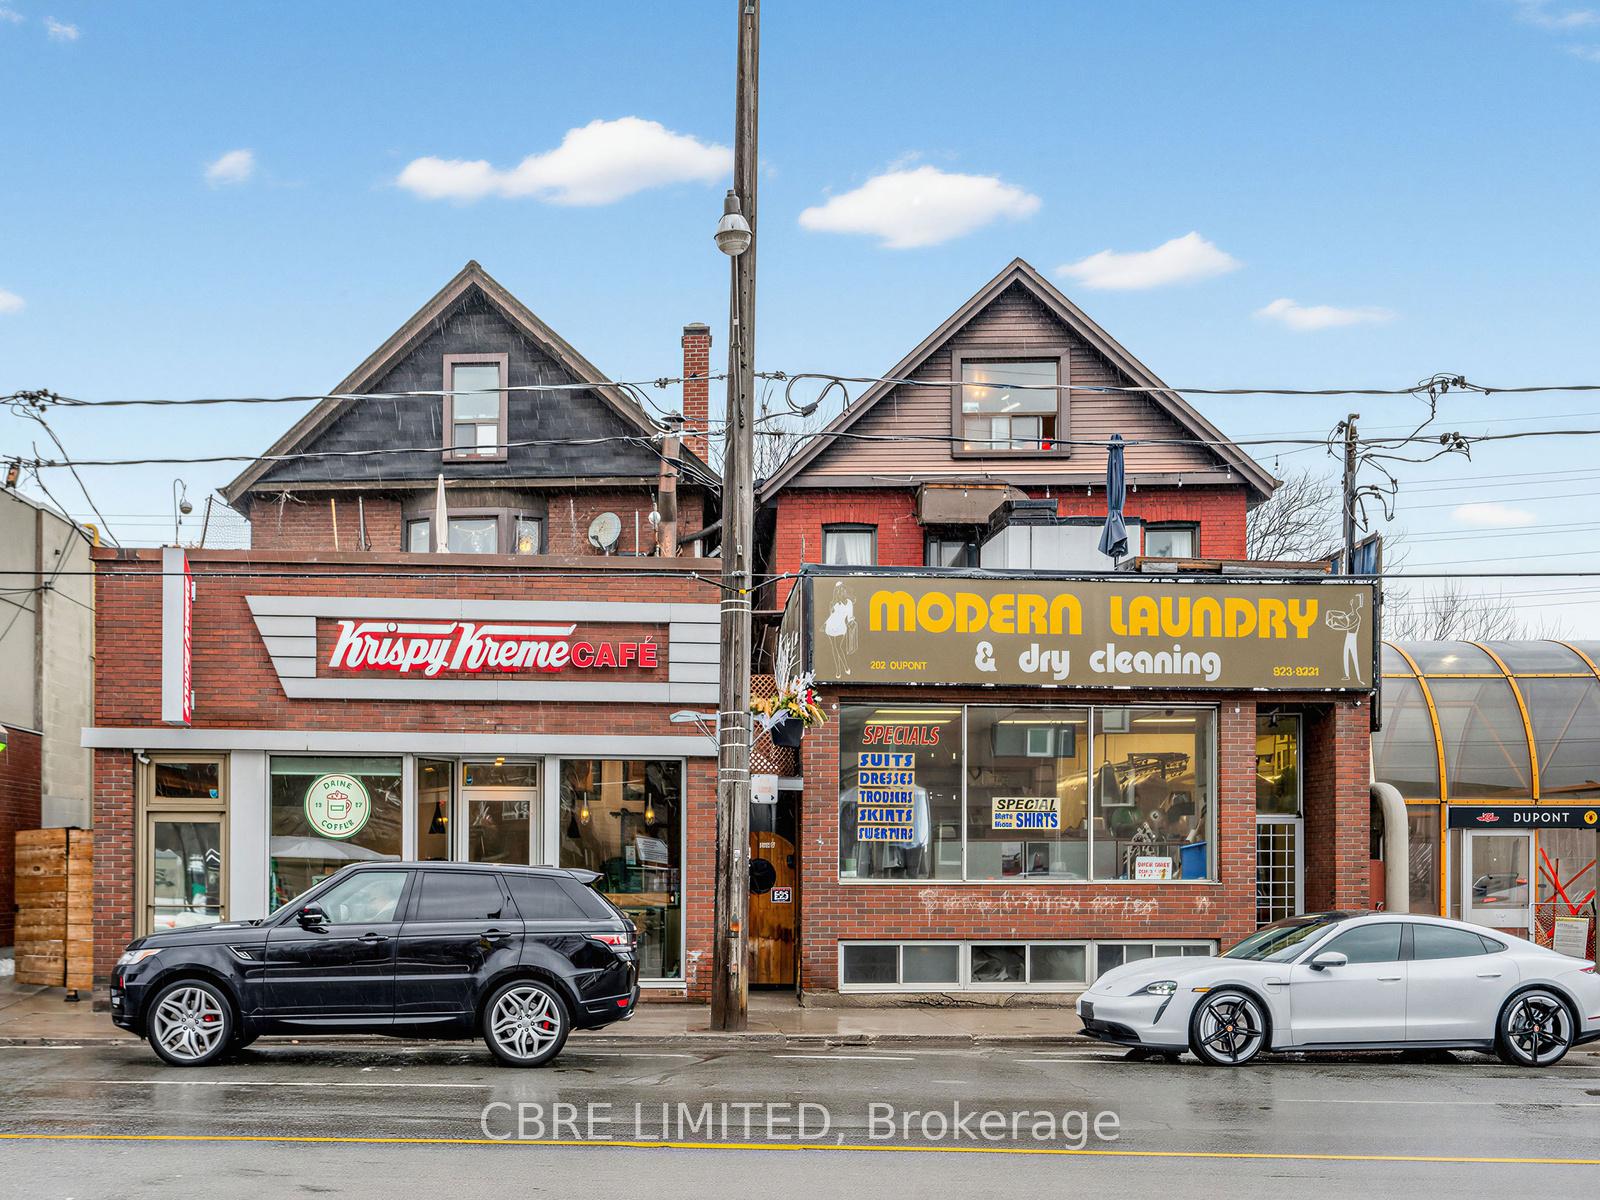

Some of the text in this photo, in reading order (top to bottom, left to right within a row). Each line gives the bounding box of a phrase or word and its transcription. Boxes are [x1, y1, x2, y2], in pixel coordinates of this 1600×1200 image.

[868, 589, 1319, 640] MODERN LAUNDRY
[328, 620, 659, 677] Krispy Kreme CAFÉ
[870, 660, 887, 670] 202
[974, 640, 1222, 682] & dry cleaning
[862, 725, 940, 746] SPECIALS
[860, 753, 913, 767] SUITS
[859, 772, 913, 785] DRESSES
[997, 799, 1056, 811] SPECIAL
[1016, 812, 1058, 828] SHIRTS
[1513, 812, 1570, 823] DUPONT
